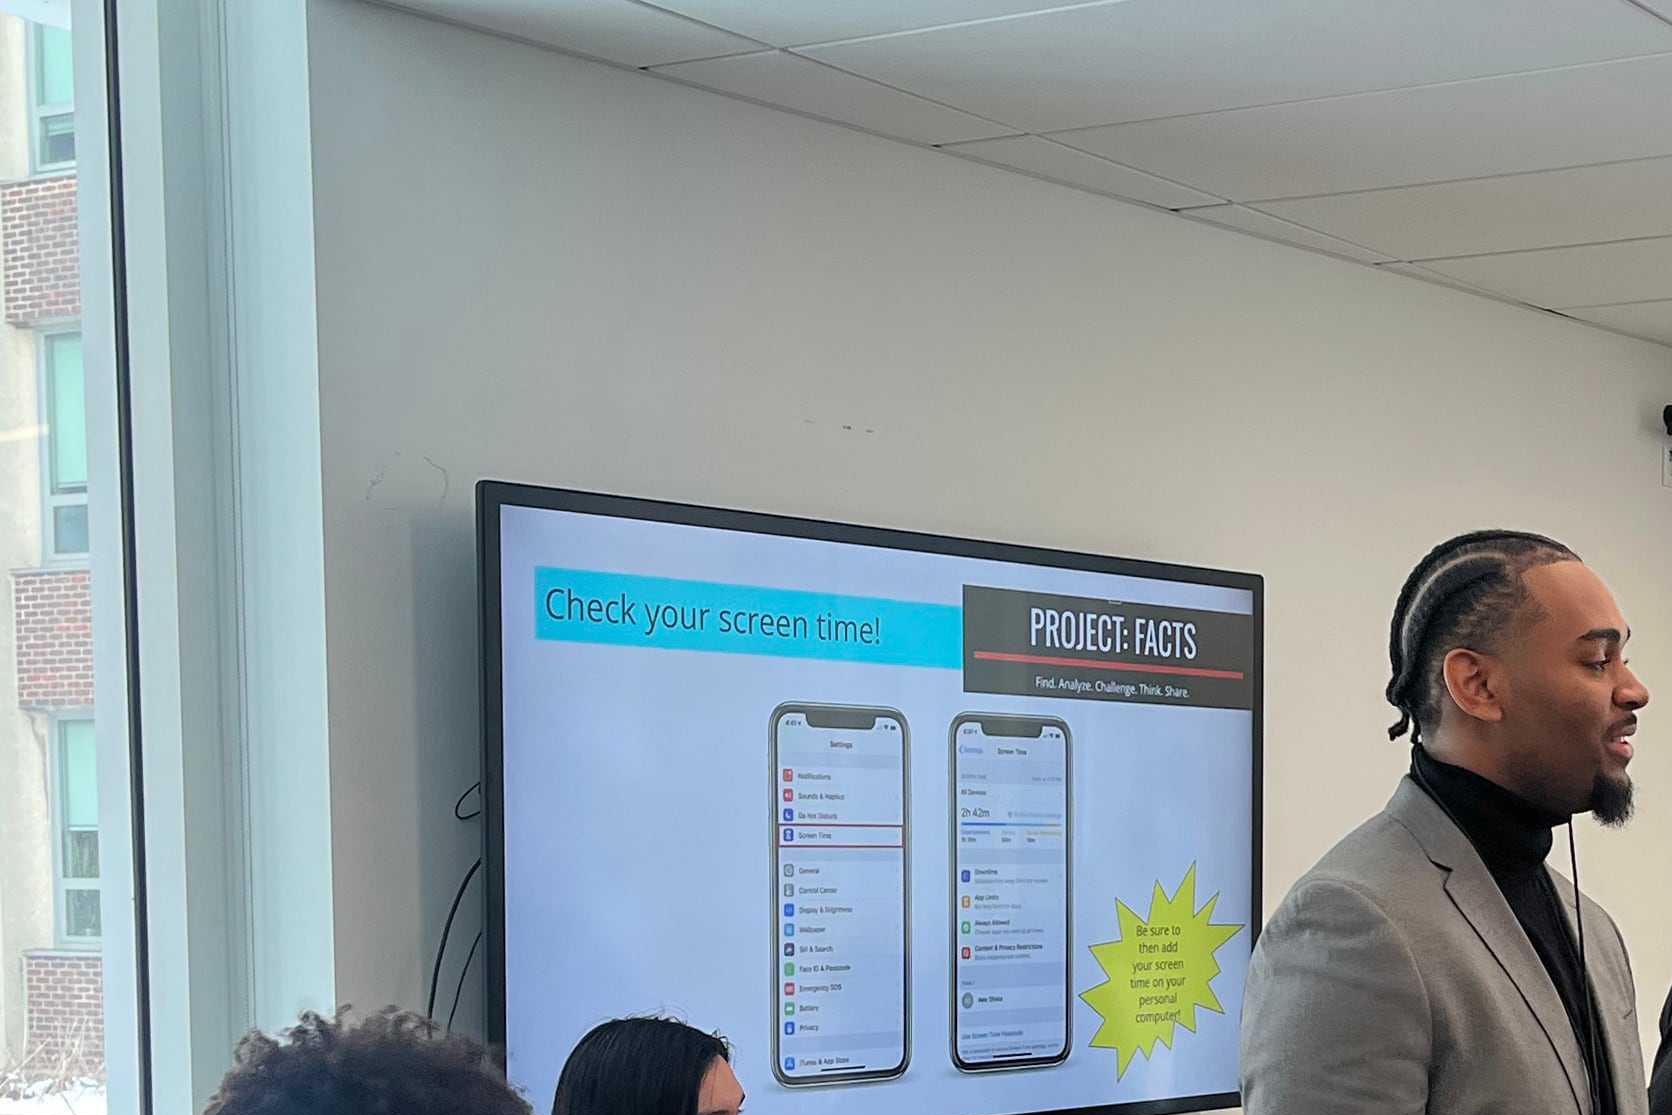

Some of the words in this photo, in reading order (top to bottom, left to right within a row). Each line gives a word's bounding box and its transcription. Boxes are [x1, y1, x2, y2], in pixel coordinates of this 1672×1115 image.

[546, 588, 637, 625] Check
[644, 602, 711, 636] your
[719, 609, 808, 639] screen
[816, 612, 881, 645] time!
[1030, 607, 1129, 653] PROJECT:
[1135, 617, 1197, 660] FACTS
[1035, 676, 1057, 689] Find.
[1058, 678, 1094, 693] Analyze.
[1095, 680, 1137, 697] Challenge.
[1139, 683, 1163, 696] Think.
[1165, 686, 1190, 698] Share.
[961, 807, 971, 818] 2h
[972, 807, 990, 818] 42m
[1136, 925, 1148, 937] Be
[1150, 926, 1170, 937] sure
[1171, 925, 1181, 936] to
[1138, 943, 1159, 954] then
[1161, 941, 1178, 953] add
[1132, 961, 1152, 975] your
[1155, 960, 1184, 971] screen
[1130, 978, 1150, 989] time
[1152, 979, 1164, 988] on
[1166, 976, 1186, 990] your
[1138, 993, 1177, 1009] personal
[1135, 1009, 1181, 1025] computer!
